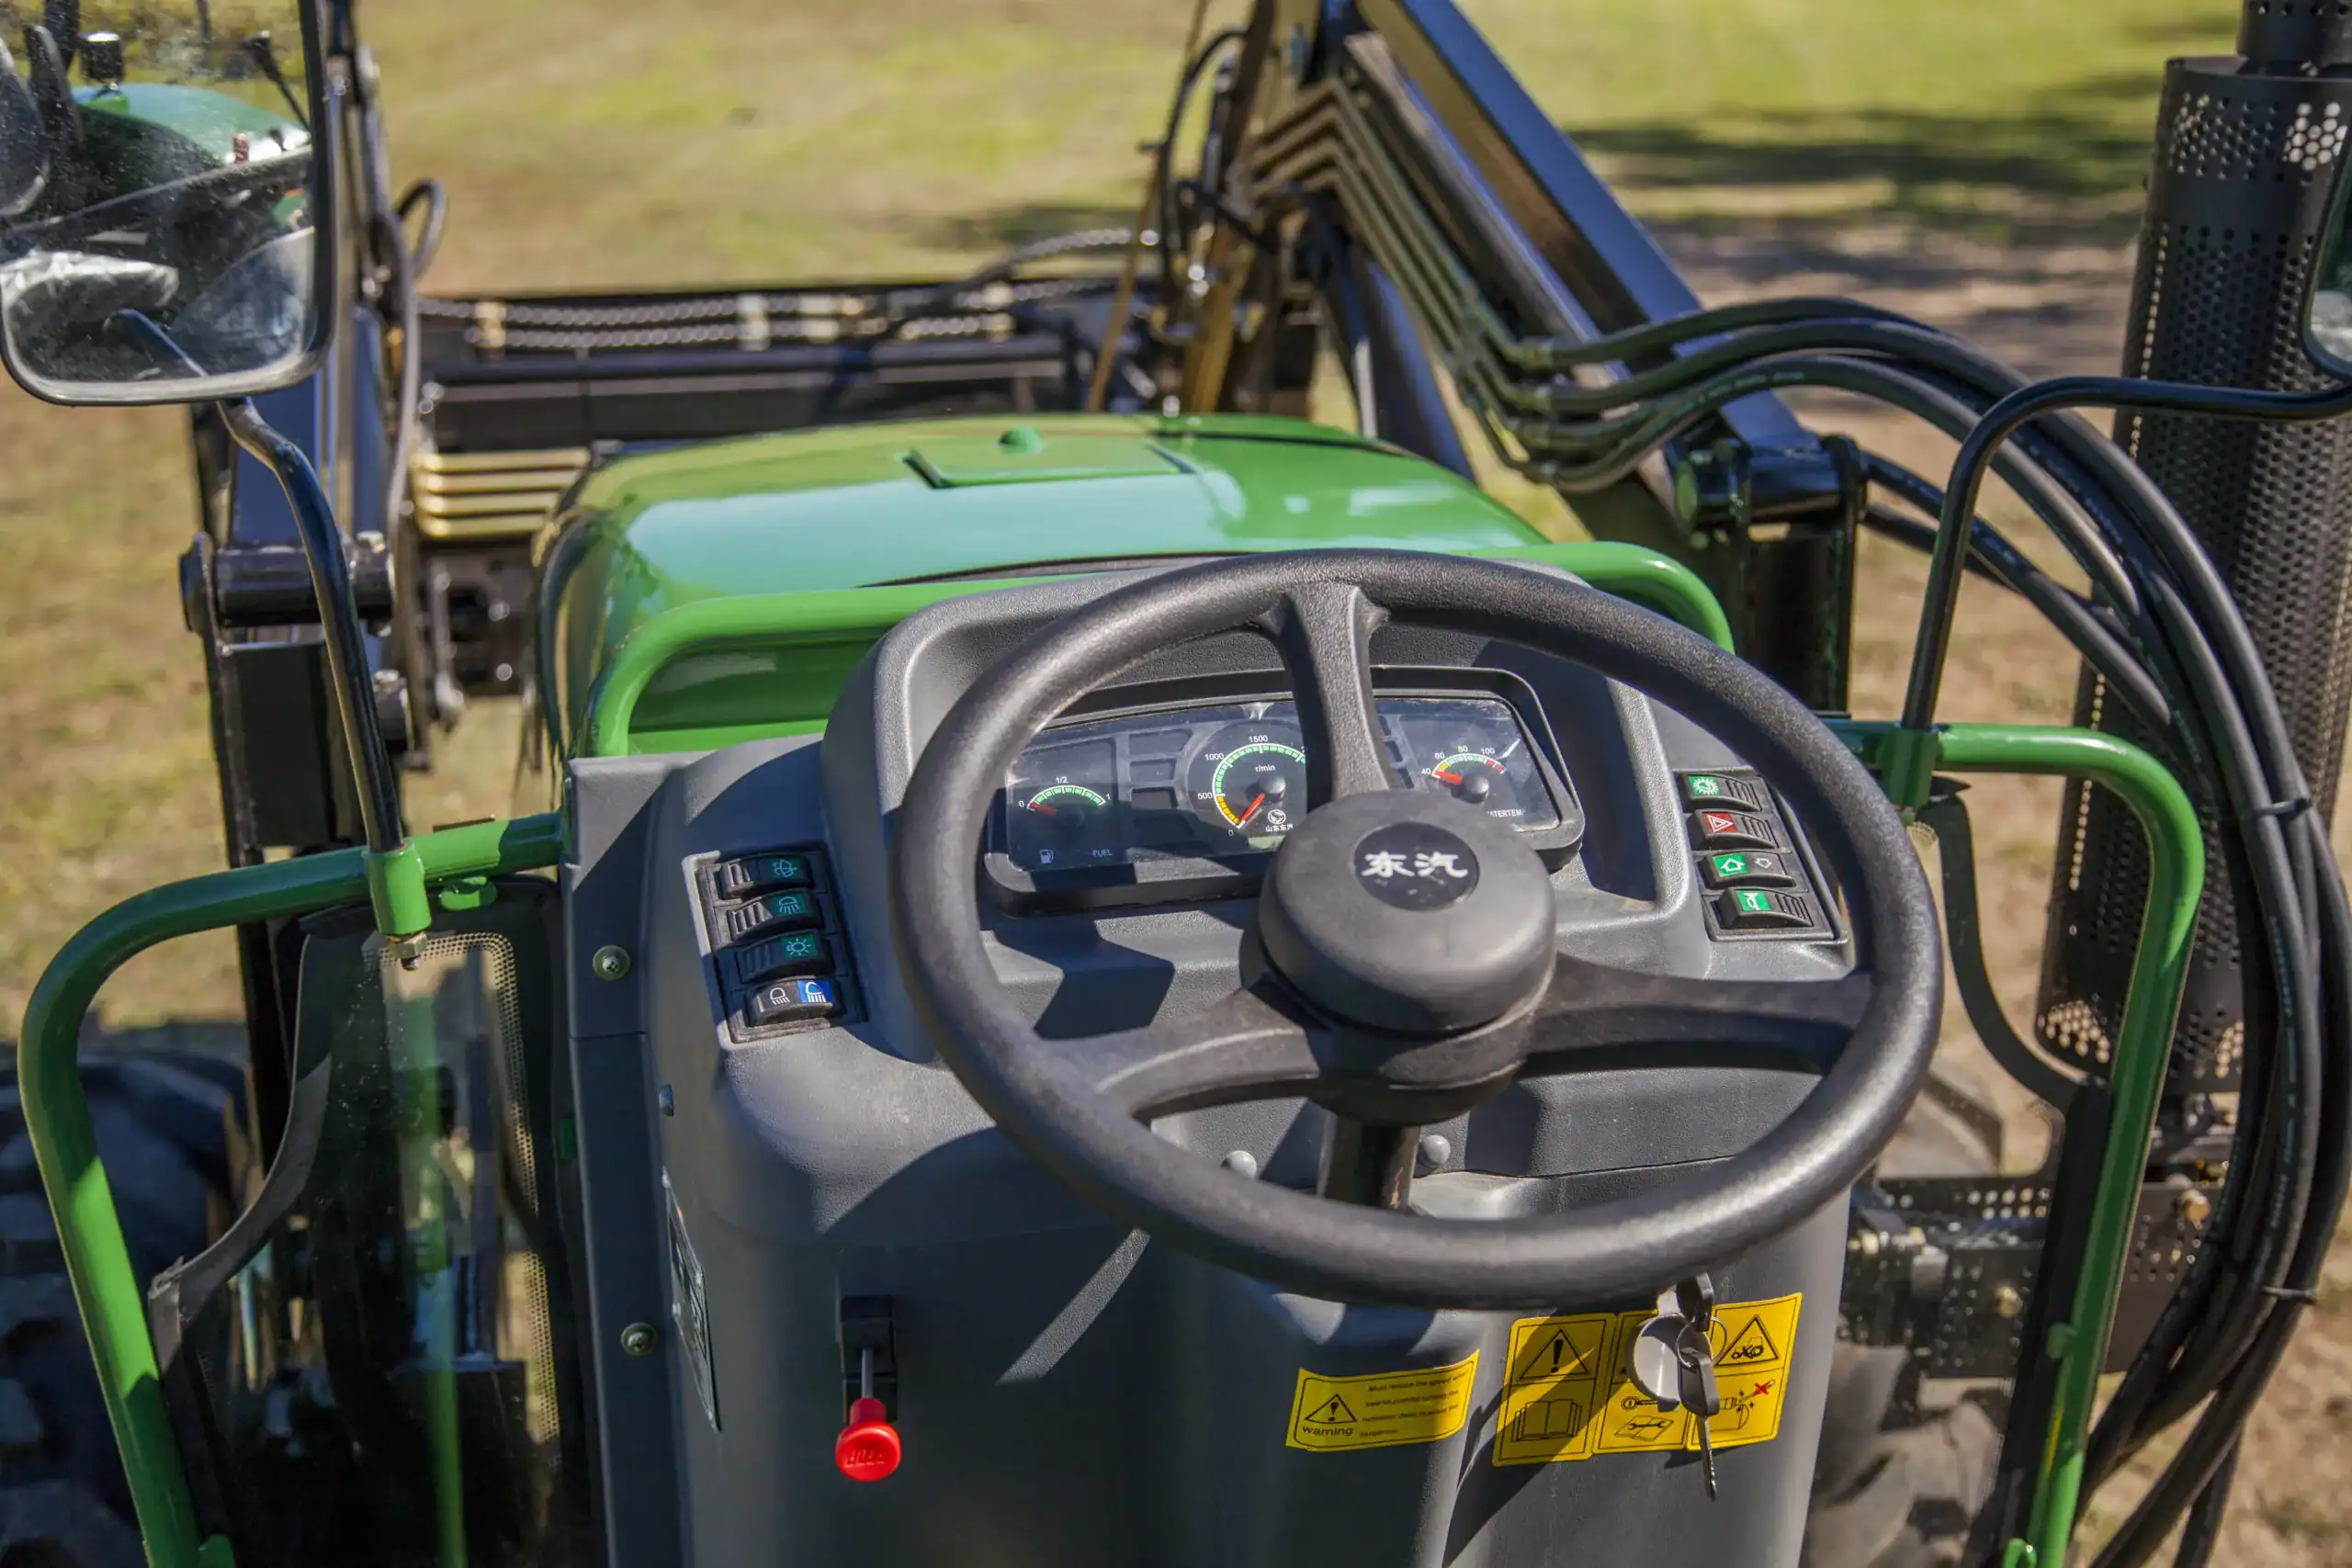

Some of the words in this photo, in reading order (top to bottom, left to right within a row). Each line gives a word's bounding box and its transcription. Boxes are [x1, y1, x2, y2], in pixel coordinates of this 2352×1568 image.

[1249, 735, 1268, 743] 1500
[1204, 752, 1225, 761] 1000
[1434, 751, 1445, 760] 60
[1255, 764, 1275, 773] r/min
[1197, 792, 1213, 800] 500
[1092, 849, 1114, 857] FUEL
[1302, 1426, 1353, 1437] warning
